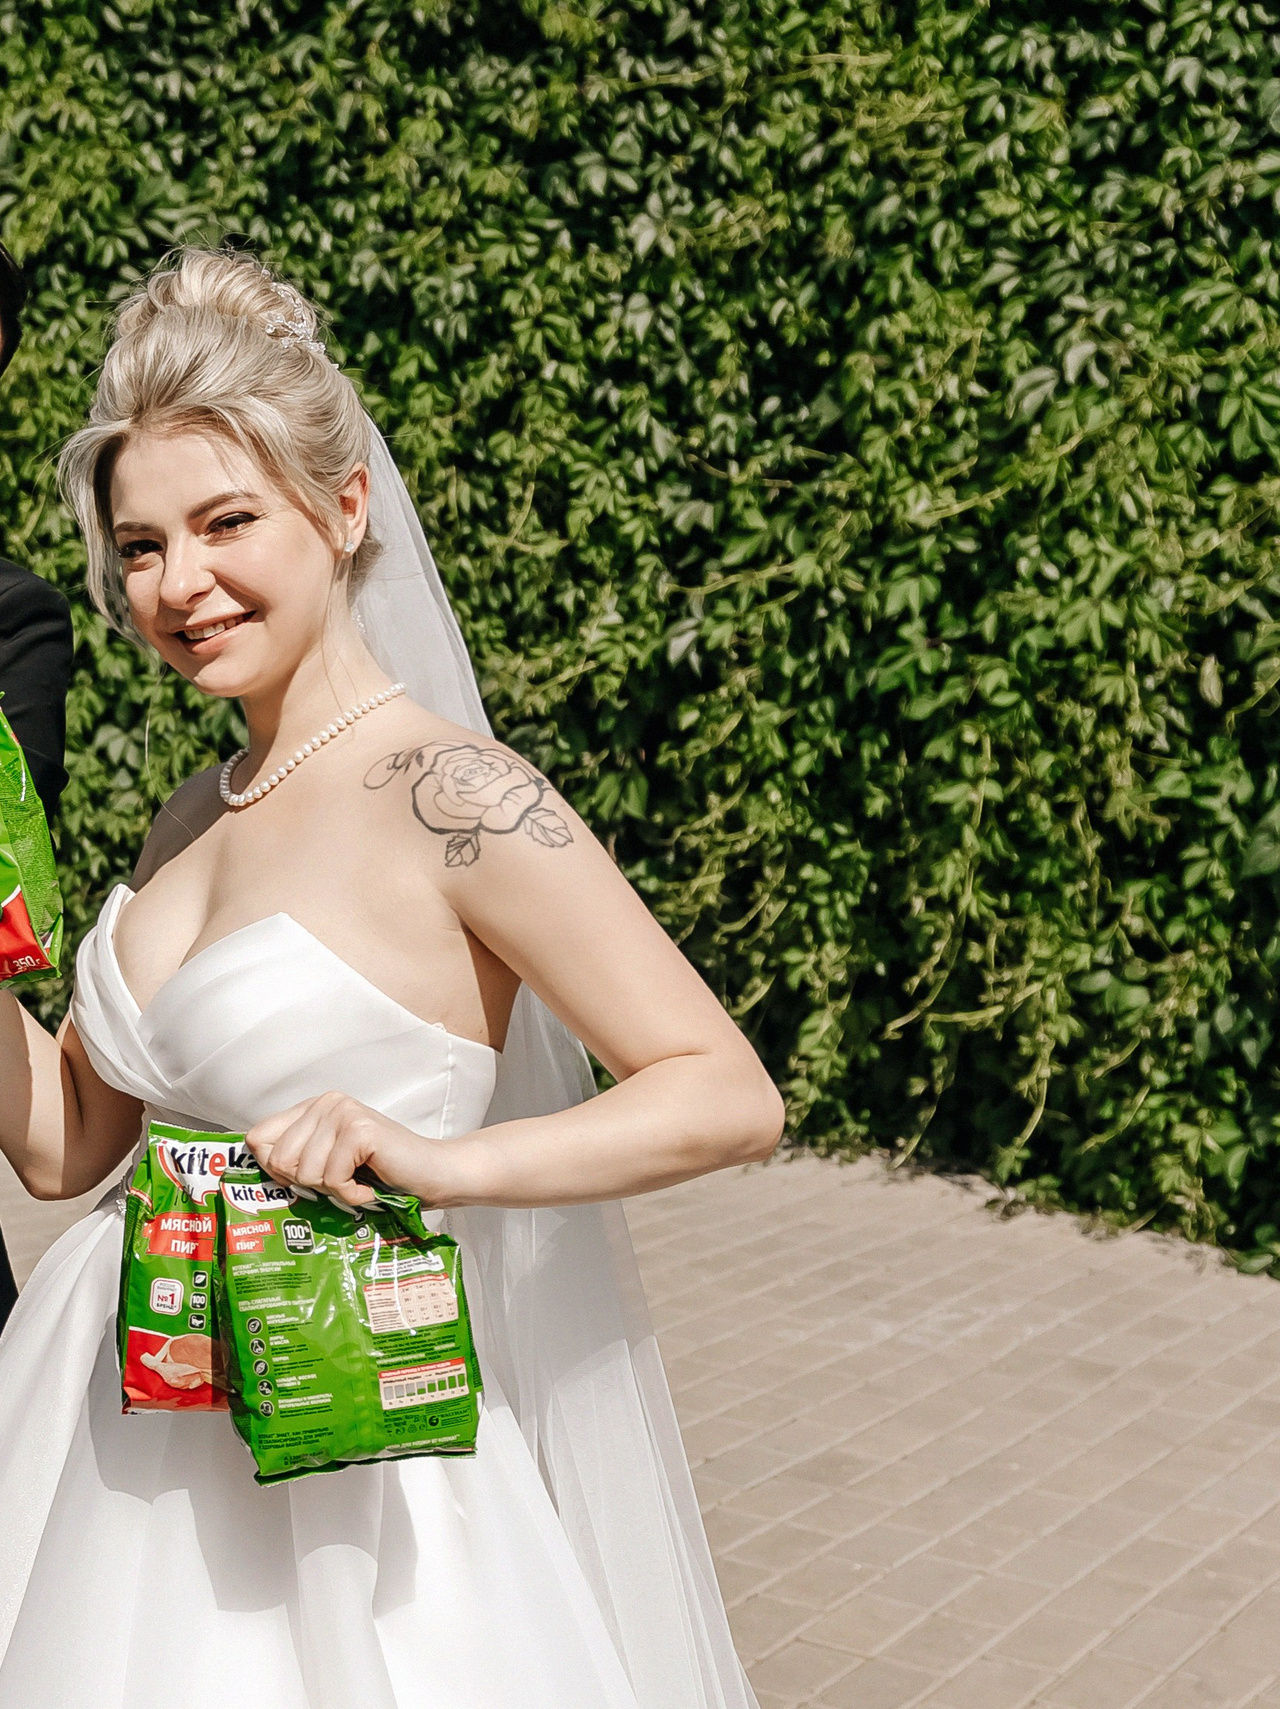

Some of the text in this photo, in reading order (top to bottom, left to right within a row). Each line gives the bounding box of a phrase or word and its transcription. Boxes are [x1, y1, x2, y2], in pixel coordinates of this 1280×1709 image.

[13, 955, 36, 970] 350
[161, 1217, 212, 1233] МЯСНОЙ
[232, 1221, 271, 1237] МЯСНОЙ
[171, 1239, 196, 1254] ПИР
[236, 1241, 256, 1251] ПИР
